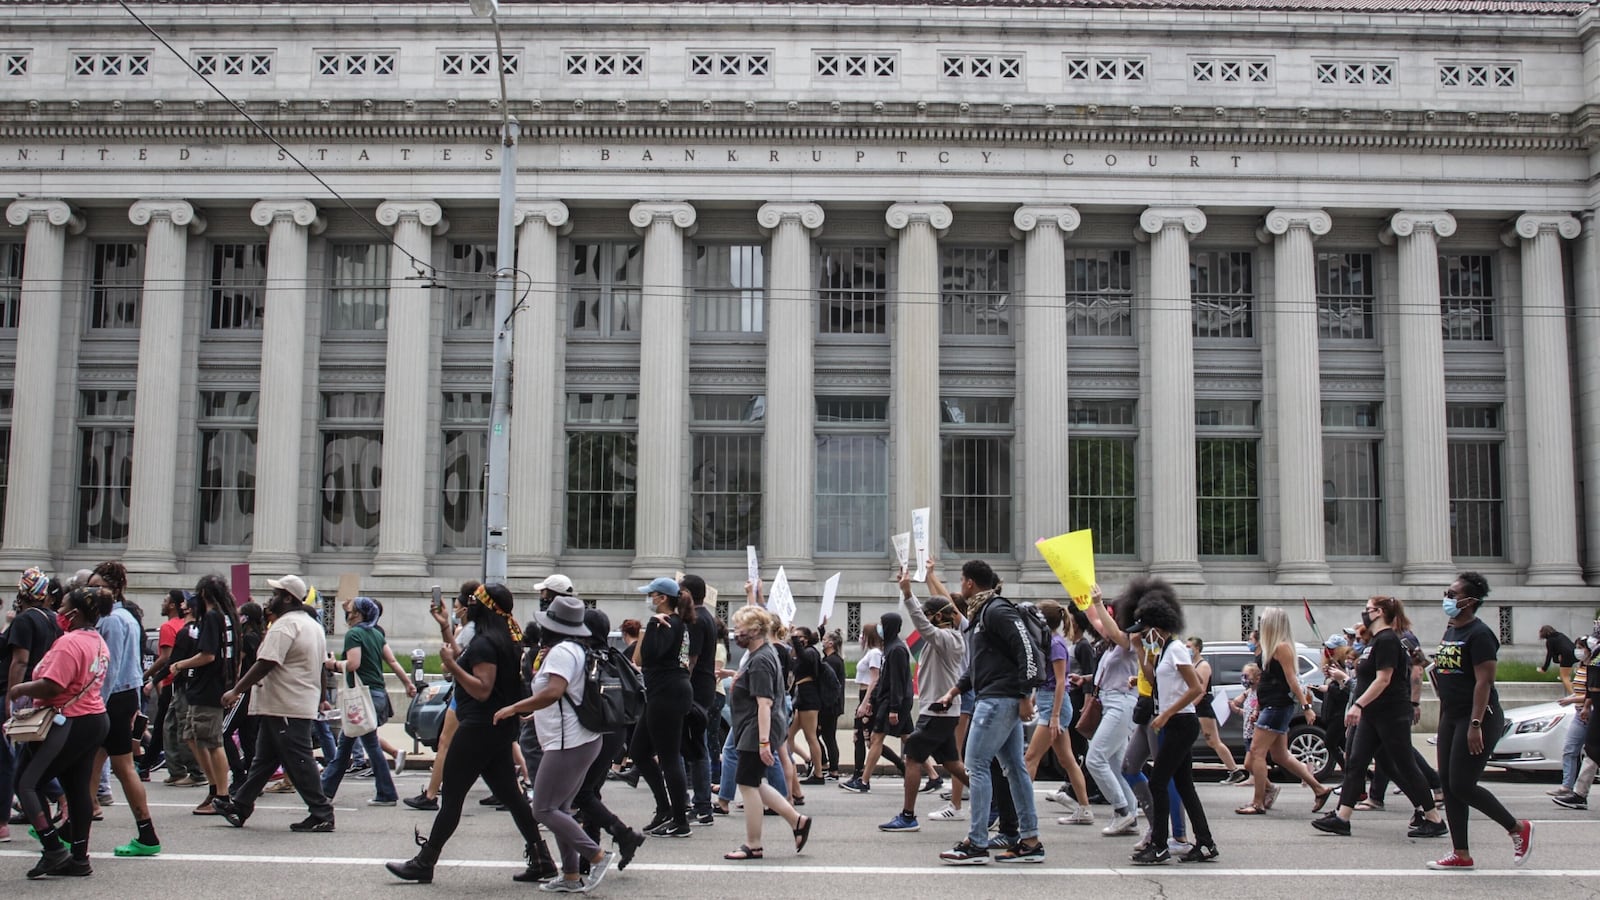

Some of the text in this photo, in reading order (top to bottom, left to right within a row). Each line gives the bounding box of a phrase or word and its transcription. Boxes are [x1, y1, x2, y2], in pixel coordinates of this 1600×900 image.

[17, 148, 1241, 168] NITED STATES BANKRUPTCY COURT
